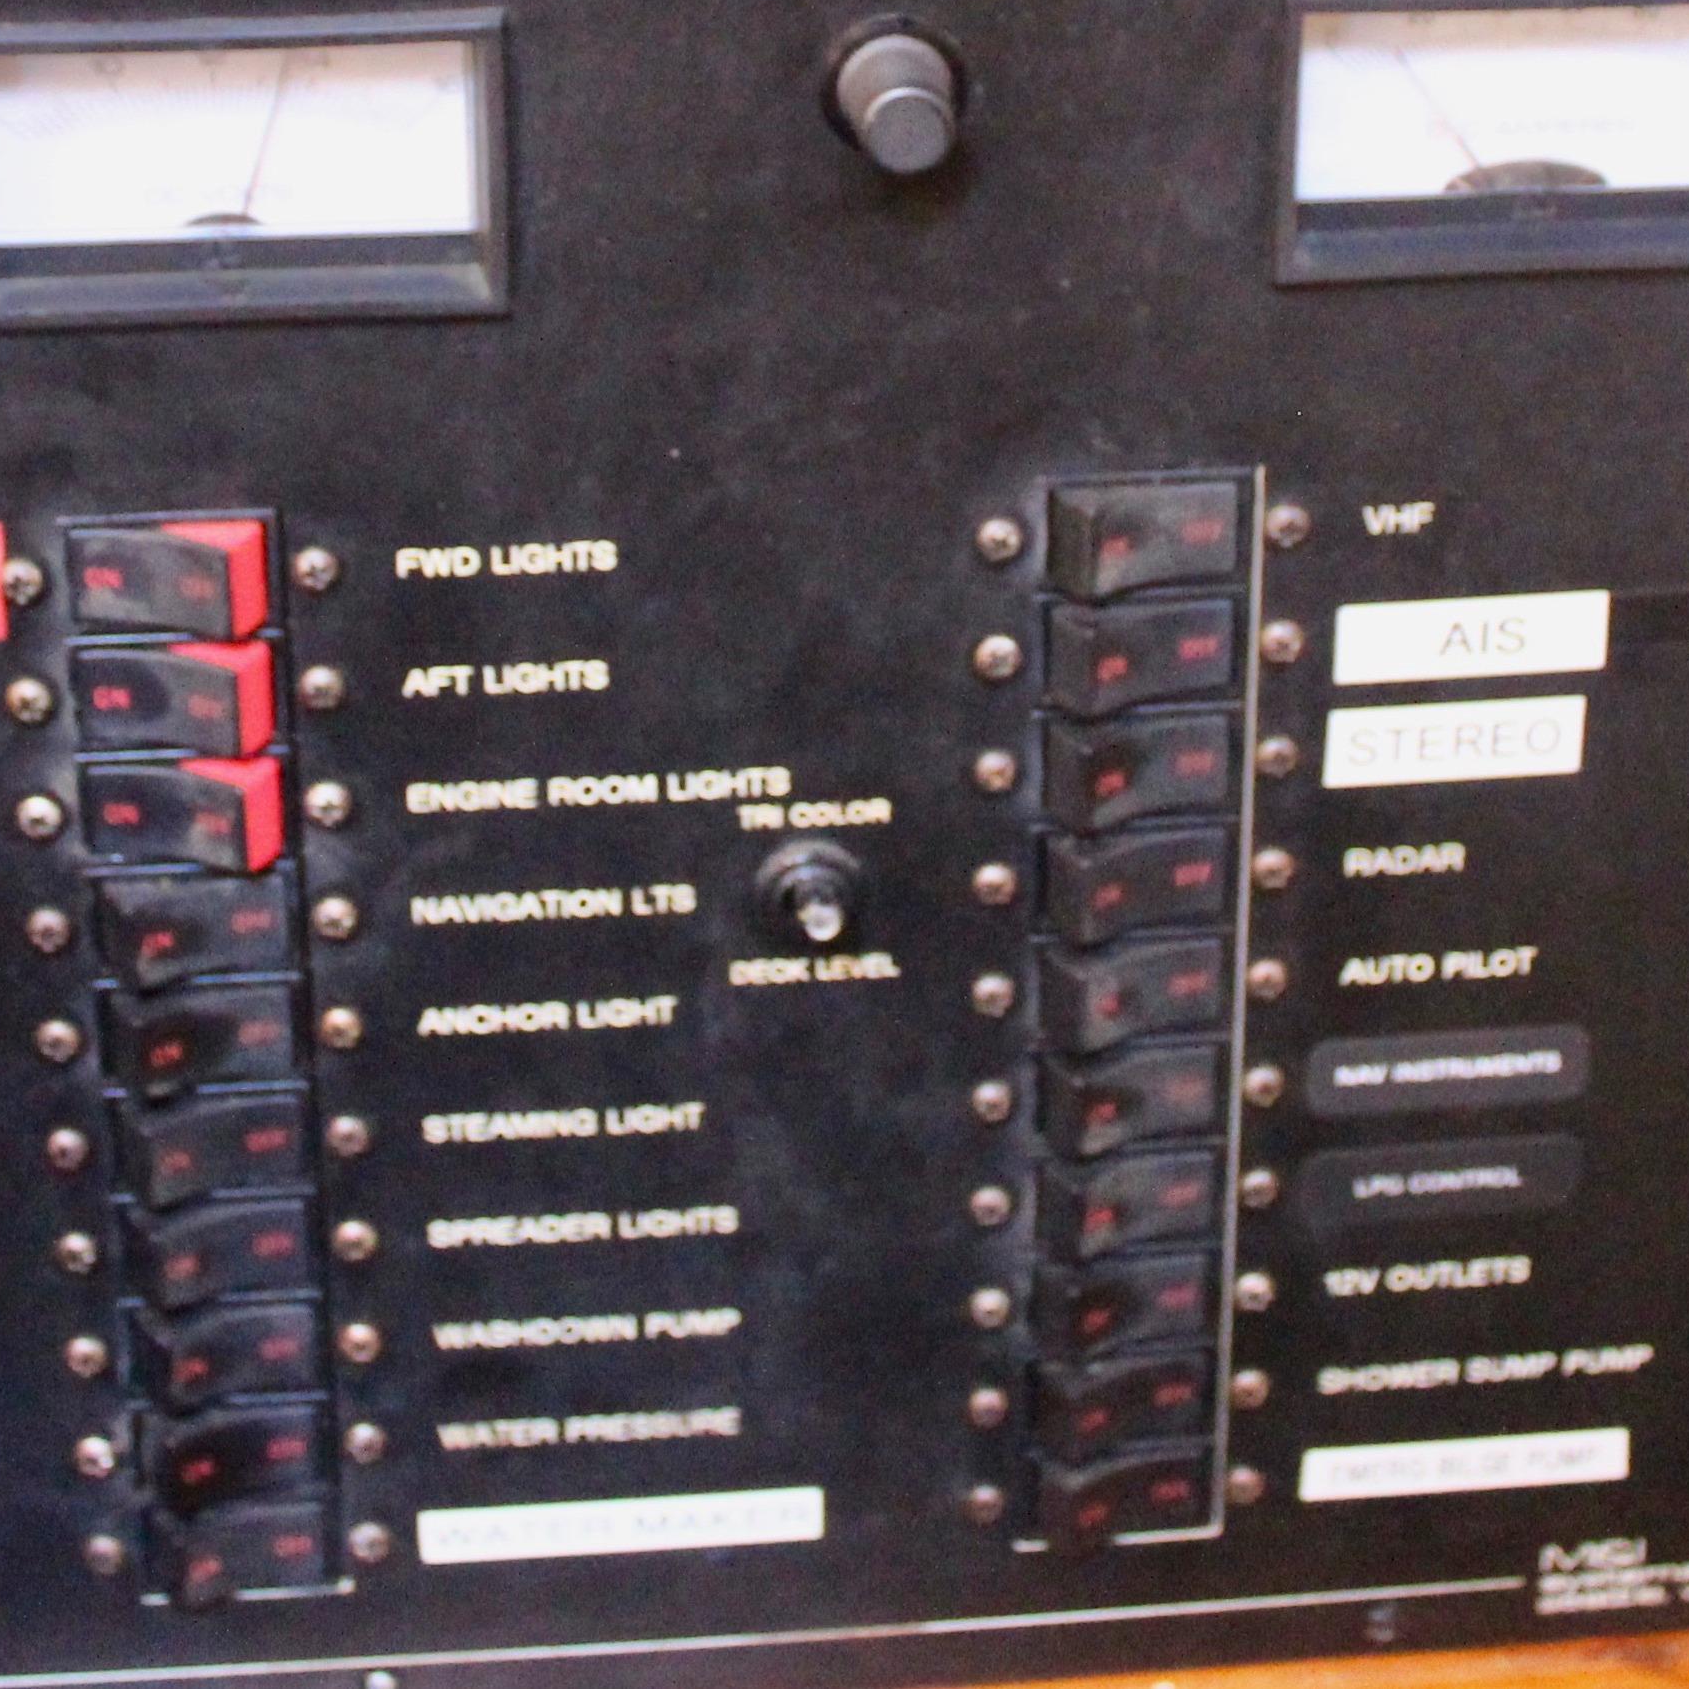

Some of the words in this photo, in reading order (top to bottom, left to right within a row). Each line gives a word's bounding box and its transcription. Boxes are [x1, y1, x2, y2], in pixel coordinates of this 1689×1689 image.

[1362, 501, 1435, 536] VHF
[395, 545, 482, 579] FWD
[489, 539, 618, 576] LIGHTS
[1439, 617, 1527, 656] AIS
[401, 664, 475, 698] AFT
[482, 659, 610, 695] LIGHTS
[1348, 718, 1561, 767] STEREO
[405, 777, 539, 814] ENGINE
[546, 773, 659, 807] ROOM
[666, 766, 792, 802] LIGHTS
[787, 797, 892, 829] COLOR
[1343, 841, 1466, 877] RADAR
[410, 888, 623, 925] NAVIGATION
[630, 883, 697, 916] LTS
[1339, 953, 1436, 986] AUTO
[1440, 945, 1538, 980] PILOT
[417, 1000, 571, 1036] ANCHOR
[575, 994, 678, 1030] LIGHT
[421, 1107, 599, 1144] STEAMING
[604, 1101, 705, 1136] LIGHT
[426, 1211, 613, 1249] SPREADER
[617, 1204, 739, 1240] LIGHTS
[1384, 1255, 1532, 1293] OUTLETS
[433, 1314, 639, 1350] WASHDOWN
[643, 1307, 742, 1339] PUMP
[1464, 1351, 1558, 1384] SUMP
[1561, 1343, 1654, 1376] PUMP
[437, 1417, 561, 1450] WATER
[563, 1406, 741, 1443] PRESSURE
